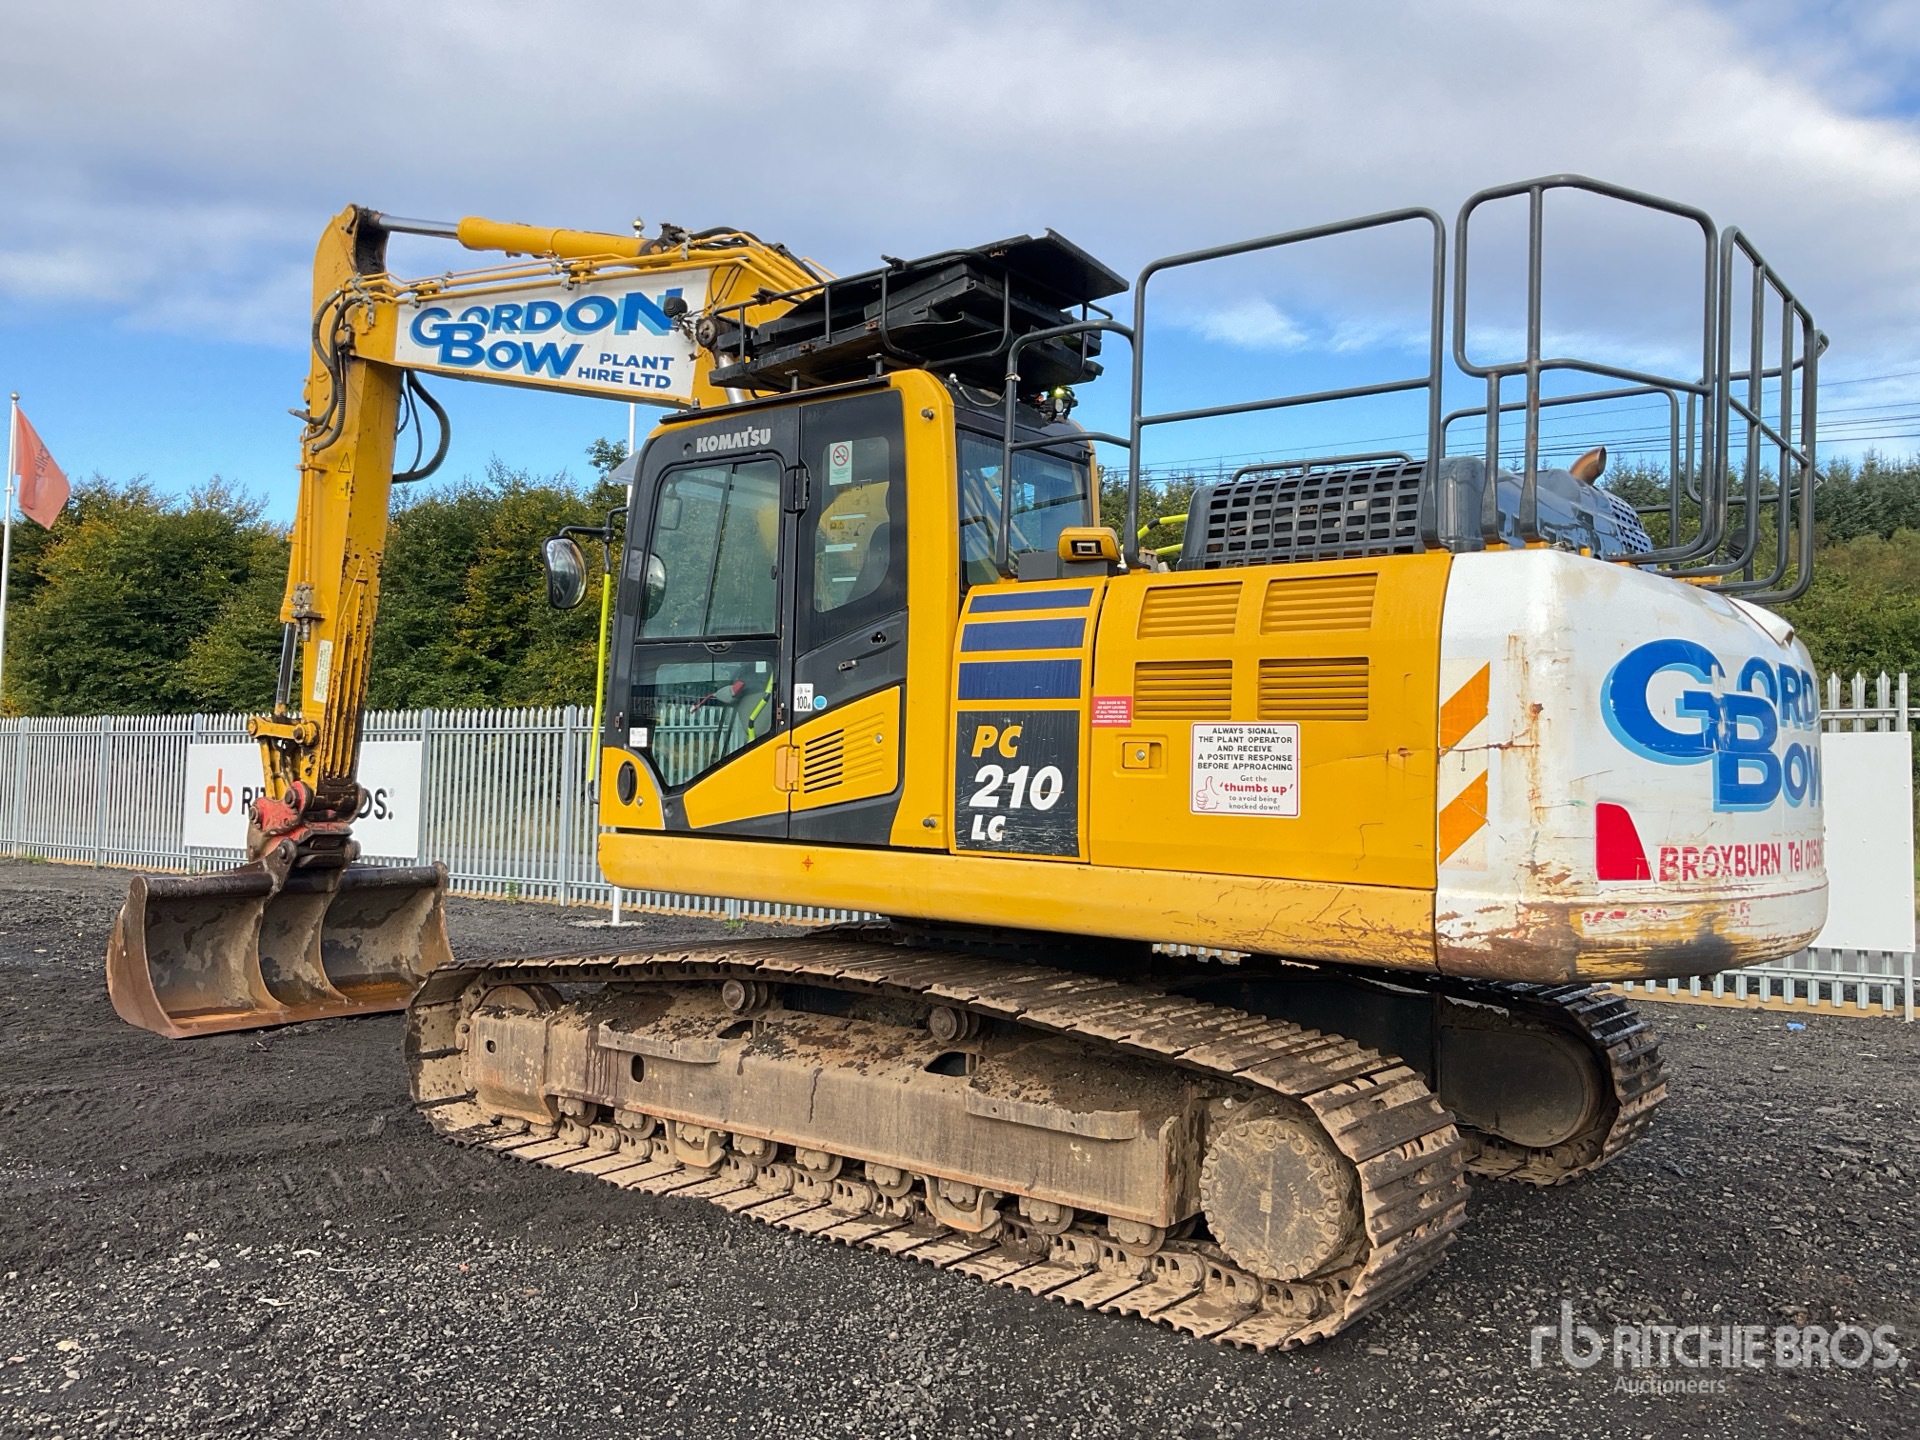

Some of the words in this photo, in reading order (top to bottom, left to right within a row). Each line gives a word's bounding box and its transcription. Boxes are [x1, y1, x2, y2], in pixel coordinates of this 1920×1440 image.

[409, 287, 684, 348] GORDON
[432, 322, 584, 378] BOW
[599, 352, 675, 371] PLANT
[577, 366, 624, 383] HIRE
[629, 373, 671, 389] LTD
[696, 426, 771, 453] KOMATSU
[971, 725, 1023, 758] PC
[1212, 727, 1244, 735] ALWAYS
[1247, 727, 1278, 735] SIGNAL
[1217, 736, 1244, 744] PLANT
[1247, 736, 1293, 744] OPERATOR
[1197, 762, 1229, 770] BEFORE
[1233, 763, 1293, 771] APPROACHING
[1207, 753, 1244, 761] POSITIVE
[1248, 754, 1293, 762] RESPONSE
[205, 768, 233, 815] rb
[969, 764, 1063, 811] 210
[1259, 796, 1278, 804] being
[971, 814, 1006, 842] LC
[1659, 842, 1781, 882] BROXBURN
[1788, 840, 1803, 872] Tel
